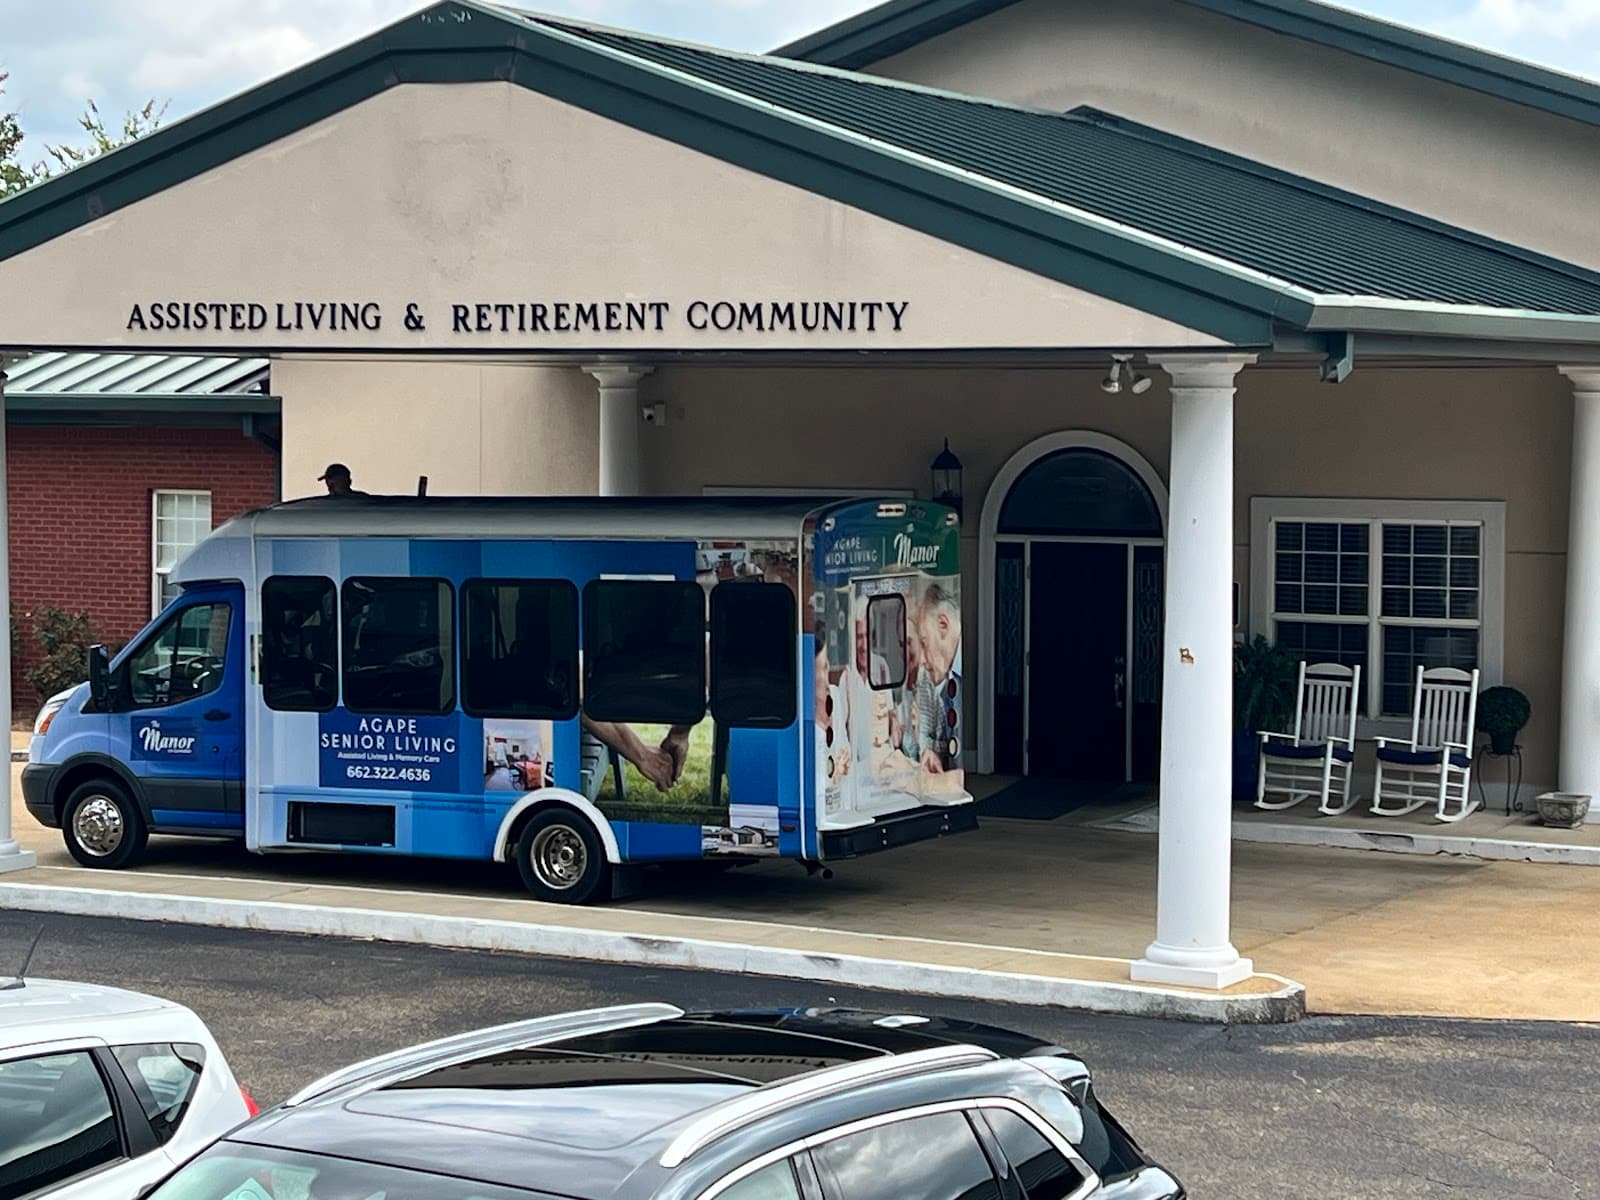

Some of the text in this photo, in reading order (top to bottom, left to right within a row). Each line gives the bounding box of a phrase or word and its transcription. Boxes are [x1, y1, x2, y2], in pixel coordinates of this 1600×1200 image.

[127, 301, 909, 331] ASSISTED LIVING & RETIREMENT COMMUNITY
[849, 549, 878, 565] LIVING
[894, 533, 940, 568] Manor
[359, 718, 417, 734] AGAPE
[139, 726, 195, 752] Manor
[321, 733, 456, 753] SENIOR LIVING
[346, 765, 432, 781] 662.322.4636
